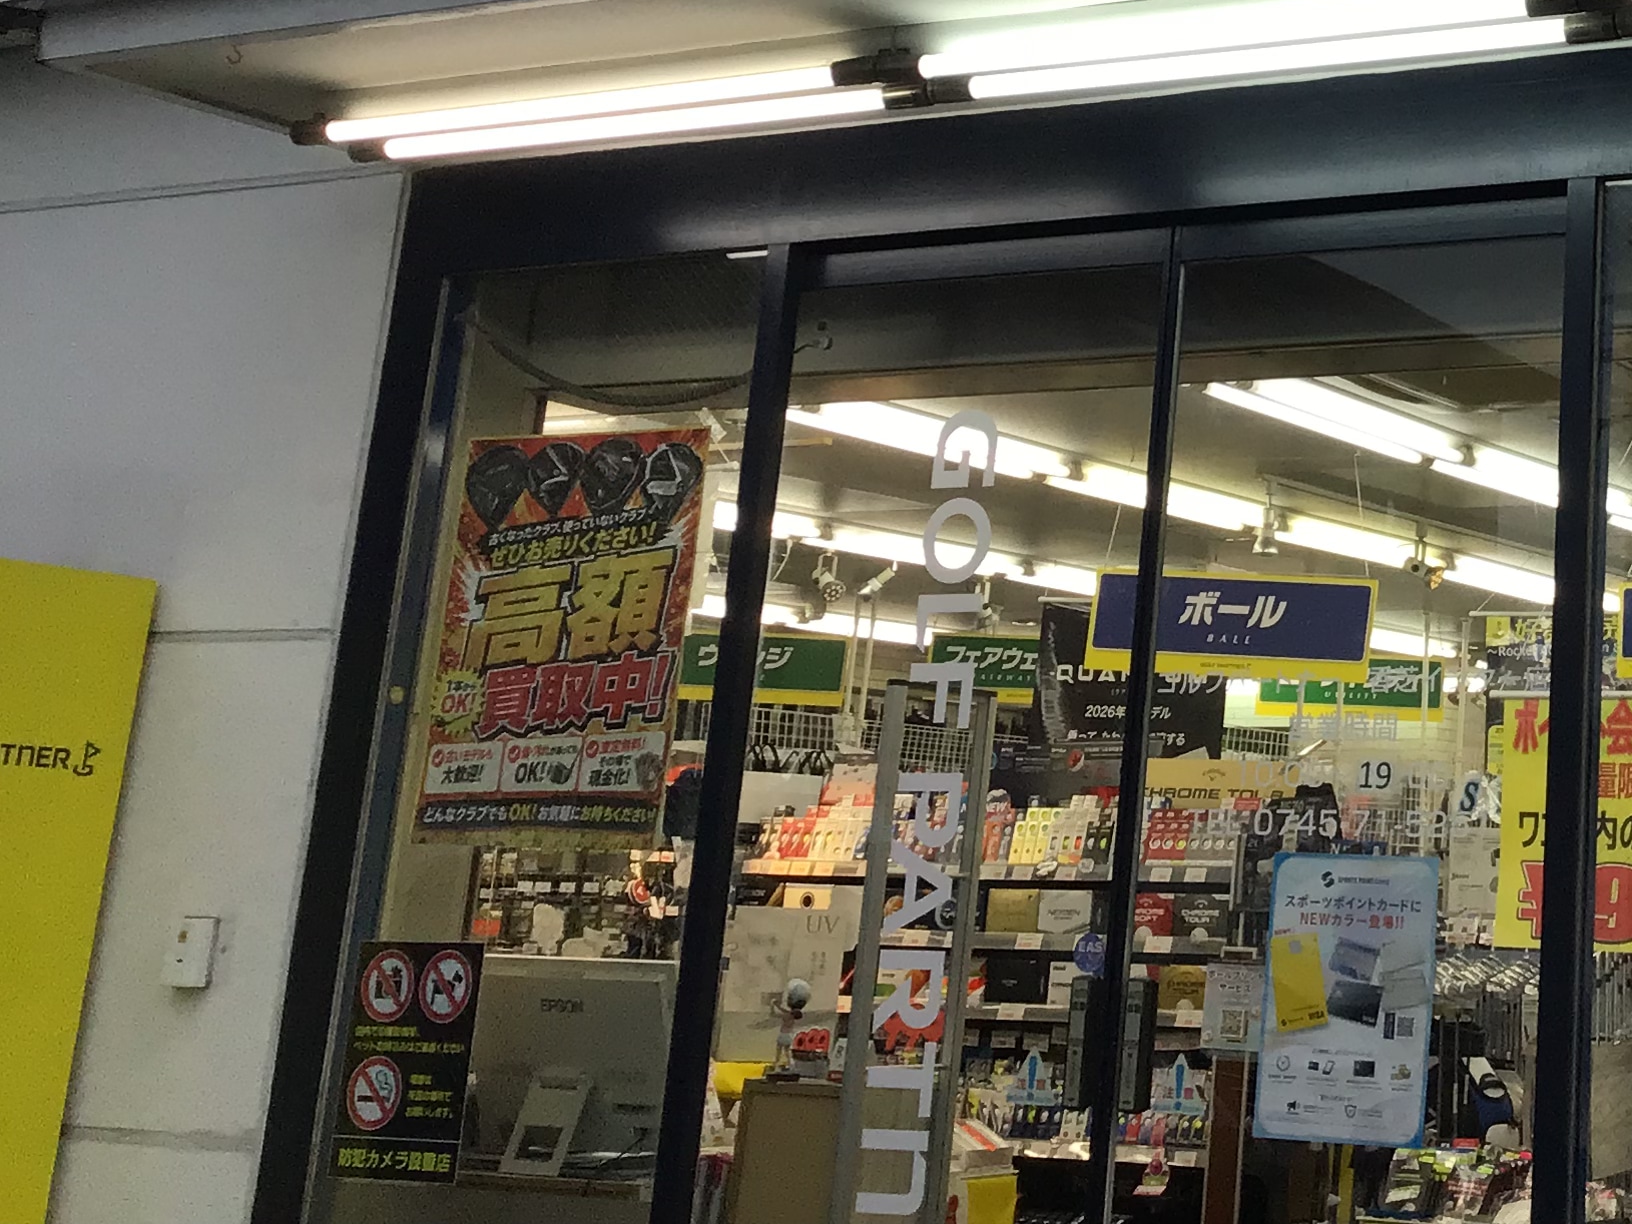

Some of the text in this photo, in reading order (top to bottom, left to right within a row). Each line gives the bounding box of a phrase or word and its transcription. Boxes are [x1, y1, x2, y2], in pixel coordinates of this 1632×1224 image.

[911, 410, 997, 728] GOLF
[464, 550, 675, 667] 高額
[1178, 591, 1287, 629] ボール
[476, 651, 671, 737] 買取中!
[980, 673, 1031, 682] AIRWAY
[1085, 705, 1171, 720] 2026年デル
[1359, 761, 1392, 789] 19
